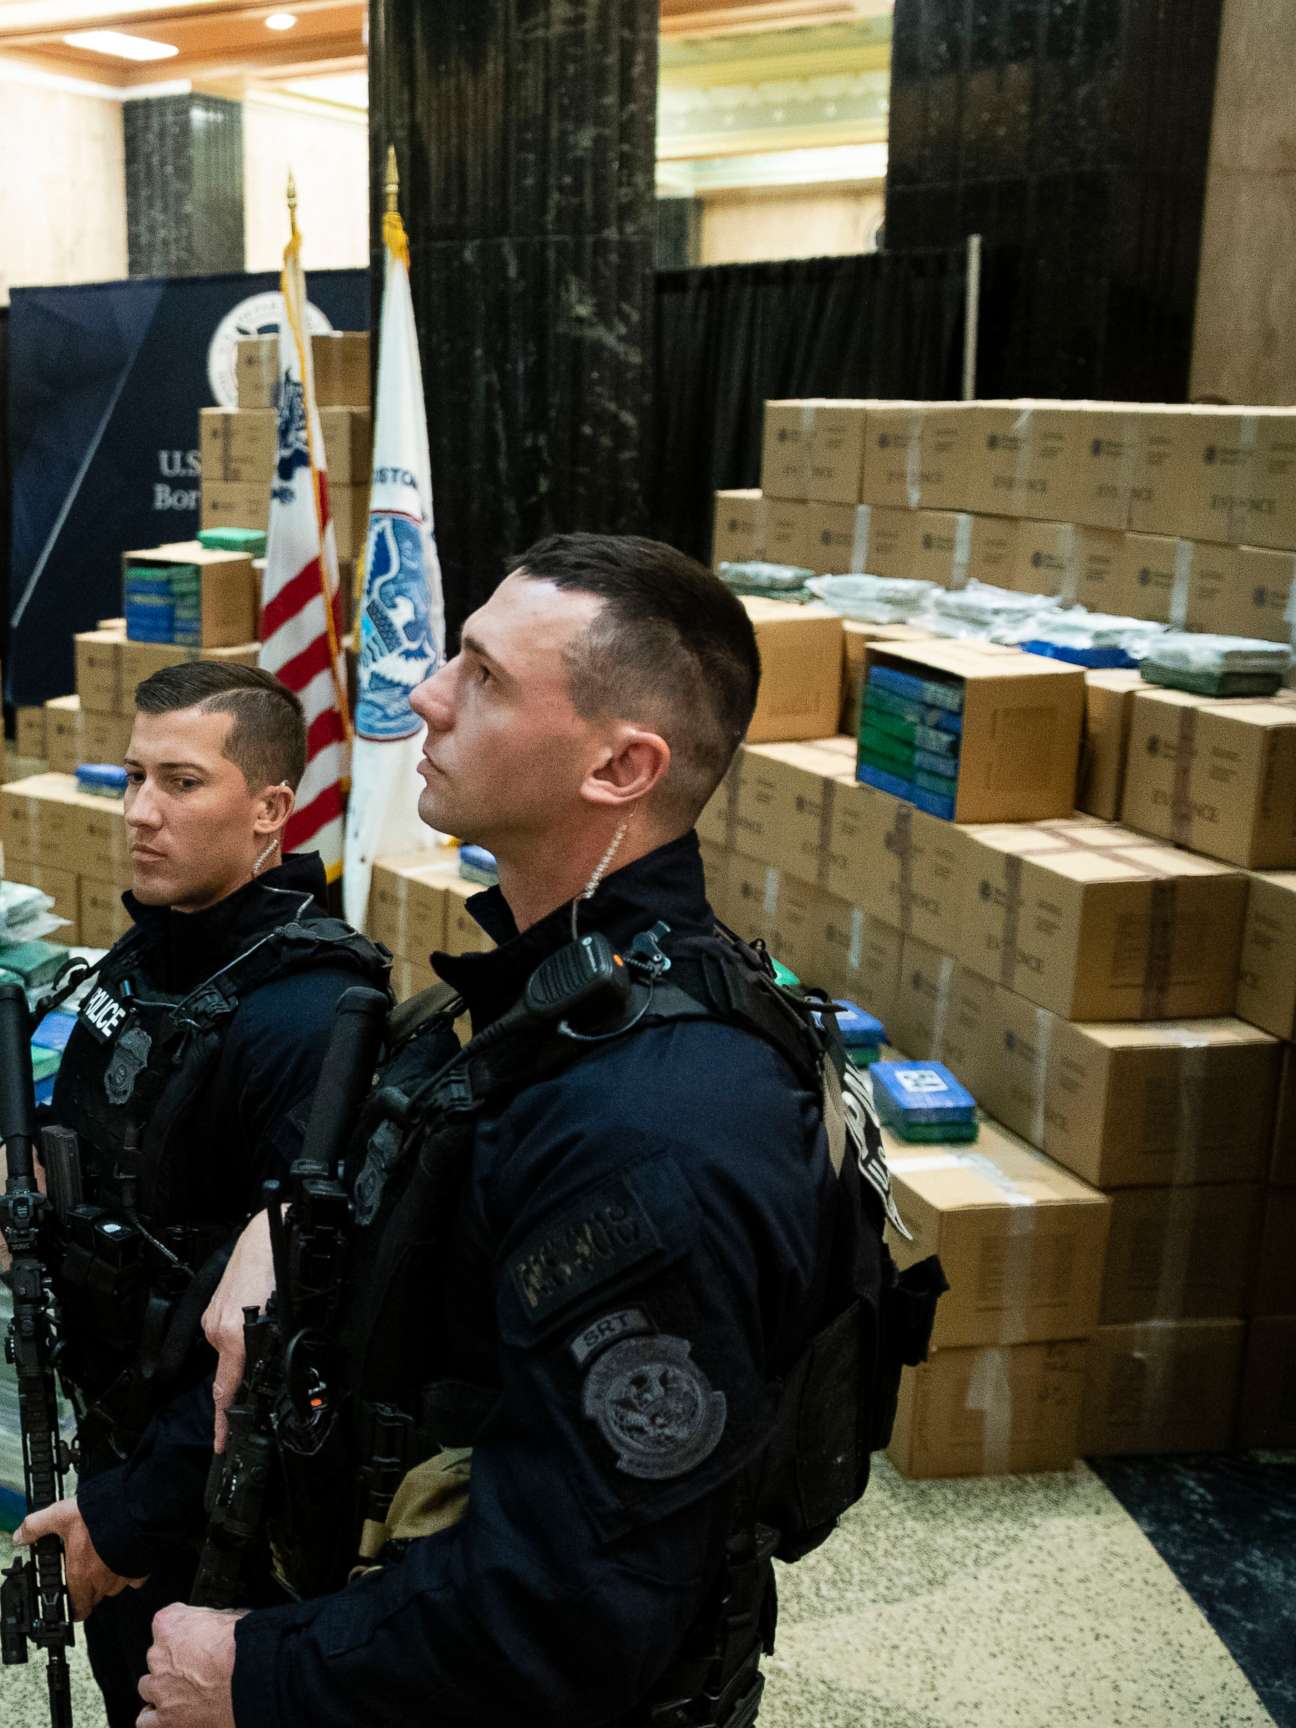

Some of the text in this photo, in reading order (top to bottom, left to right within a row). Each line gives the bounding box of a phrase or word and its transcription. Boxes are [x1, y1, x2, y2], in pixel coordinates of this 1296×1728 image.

[158, 449, 201, 477] U.S
[152, 483, 201, 510] Bor
[583, 1313, 630, 1352] SRT
